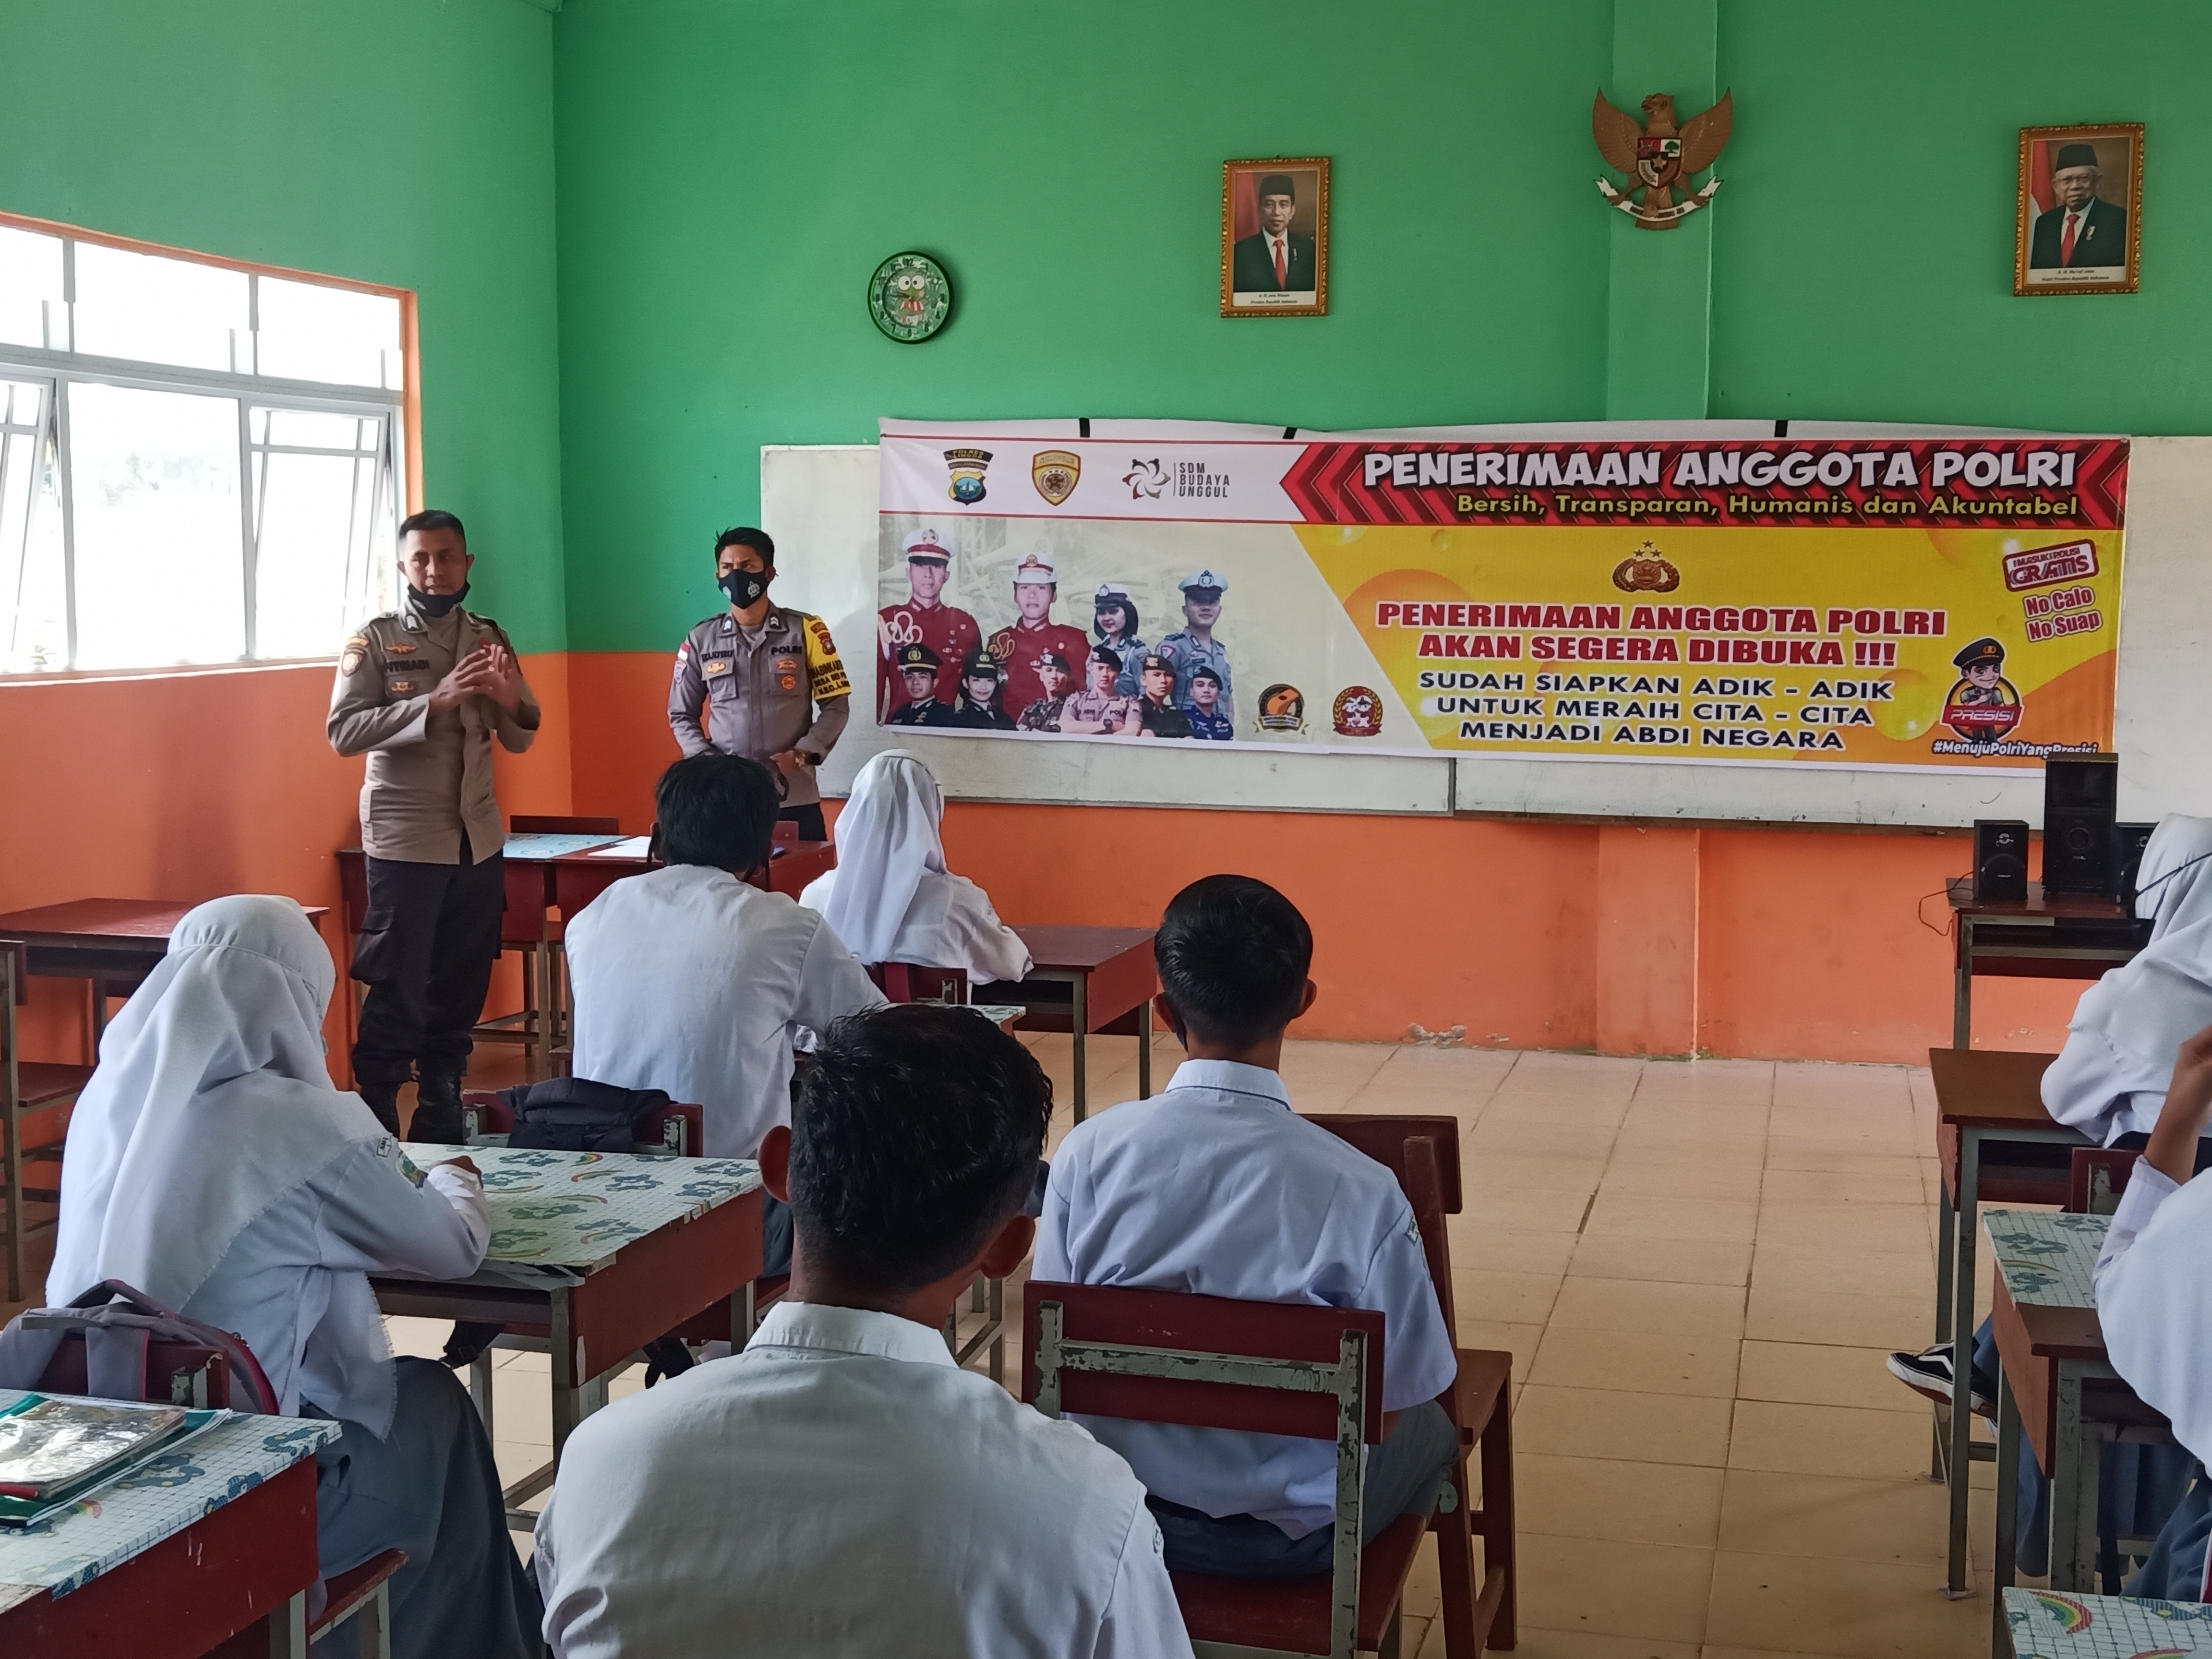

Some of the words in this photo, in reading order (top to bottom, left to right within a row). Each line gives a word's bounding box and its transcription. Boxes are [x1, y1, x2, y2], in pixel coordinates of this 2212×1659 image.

[1179, 462, 1205, 473] SDM
[1180, 474, 1229, 485] BUDAYA
[1365, 452, 1660, 486] PENERIMAAN
[1672, 451, 1919, 487] ANGGOTA
[1932, 451, 2076, 487] POLRI
[1179, 486, 1228, 497] UNGGUL
[1458, 495, 1545, 515] Bersih,
[1555, 495, 1718, 517] Transparan,
[1730, 495, 1852, 514] Humanis
[1864, 495, 1916, 514] dan
[1928, 495, 2077, 515] Akuntabel
[2011, 555, 2090, 584] GRATIS
[2025, 598, 2050, 615] No
[2052, 589, 2092, 610] Calo
[1378, 603, 1620, 629] PENERIMAAN
[1630, 607, 1818, 632] ANGGOTA
[1828, 610, 1945, 635] POLRI
[2028, 622, 2052, 639] No
[2055, 612, 2100, 634] Suap
[1419, 634, 1521, 658] AKAN
[1531, 636, 1679, 661] SEGERA
[1689, 639, 1844, 665] DIBUKA
[1854, 642, 1896, 666] !!!
[1419, 672, 1523, 690] SUDAH
[1536, 675, 1679, 694] SIAPKAN
[1693, 678, 1773, 696] ADIK
[1810, 681, 1892, 699] ADIK
[1437, 697, 1543, 715] UNTUK
[1556, 700, 1679, 719] MERAIH
[1693, 703, 1764, 721] CITA
[1800, 706, 1872, 724] CITA
[1950, 709, 2015, 721] PRESISI
[1460, 721, 1600, 741] MENJADI
[1613, 726, 1689, 744] ABDI
[1703, 729, 1843, 749] NEGARA
